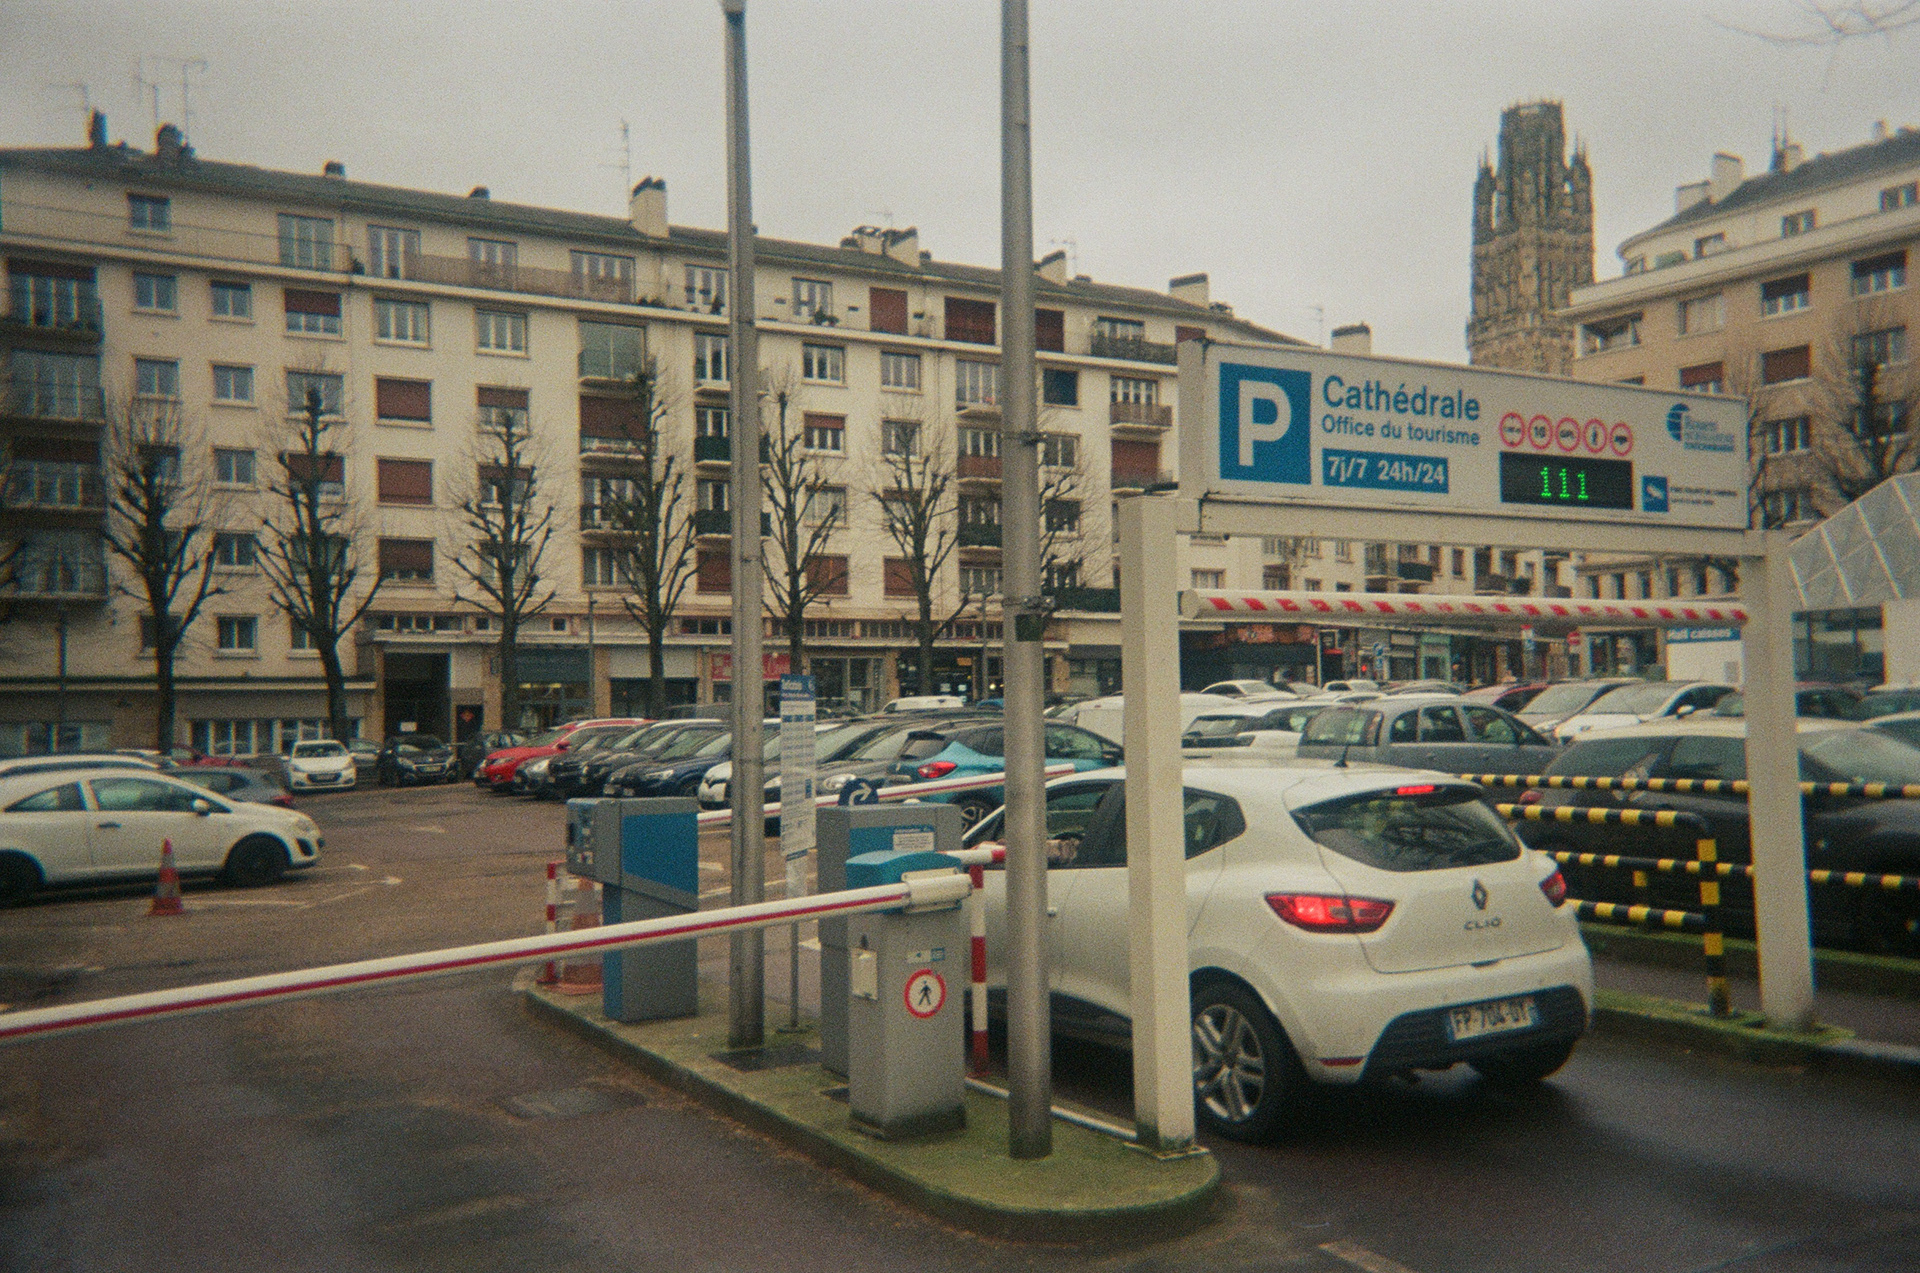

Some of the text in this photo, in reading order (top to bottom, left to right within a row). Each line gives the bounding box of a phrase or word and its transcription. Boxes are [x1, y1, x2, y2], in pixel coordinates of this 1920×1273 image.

[1322, 375, 1480, 421] Cathédrale
[1239, 379, 1291, 467] P
[1321, 413, 1480, 446] Office du tourisme
[1328, 456, 1445, 485] 7j/7 24h/24
[1540, 466, 1589, 499] 111
[1463, 917, 1502, 930] CLIO
